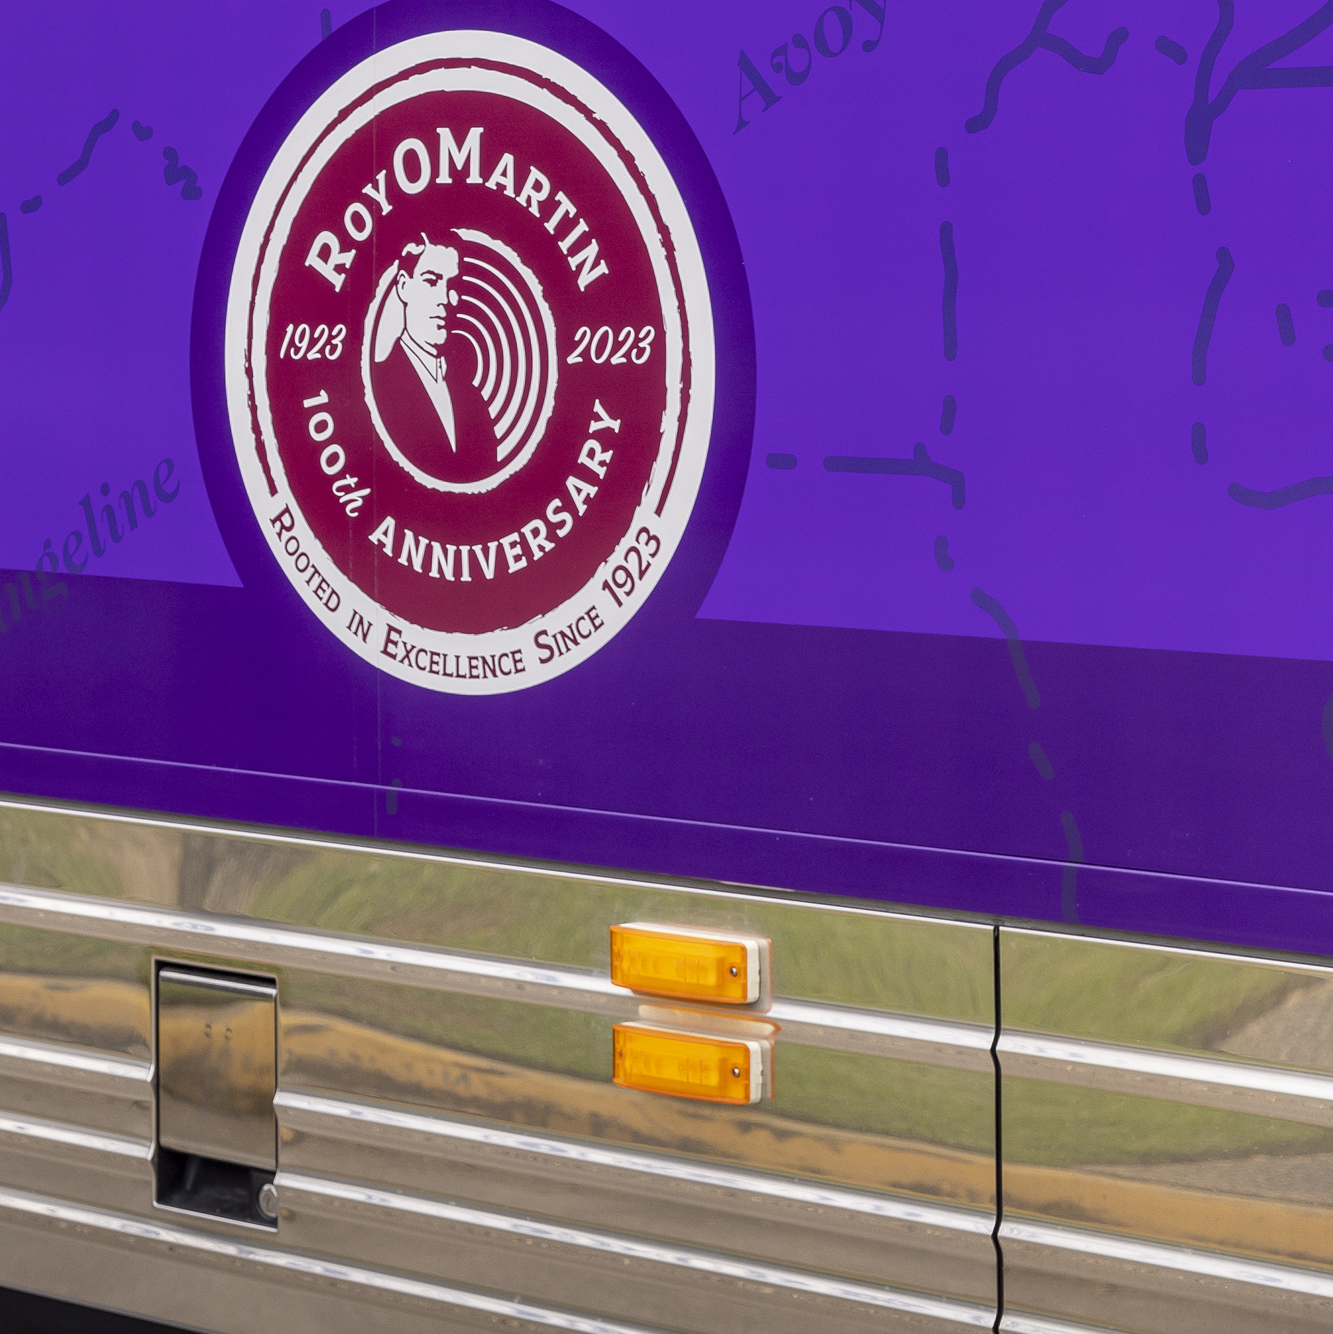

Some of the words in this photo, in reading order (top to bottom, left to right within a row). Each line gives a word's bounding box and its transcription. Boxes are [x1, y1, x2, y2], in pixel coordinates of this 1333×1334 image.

[279, 323, 346, 361] 1923
[566, 325, 655, 366] 2023
[302, 389, 372, 518] 100th
[367, 398, 622, 582] ANNIVERSARY
[601, 525, 661, 609] 1923
